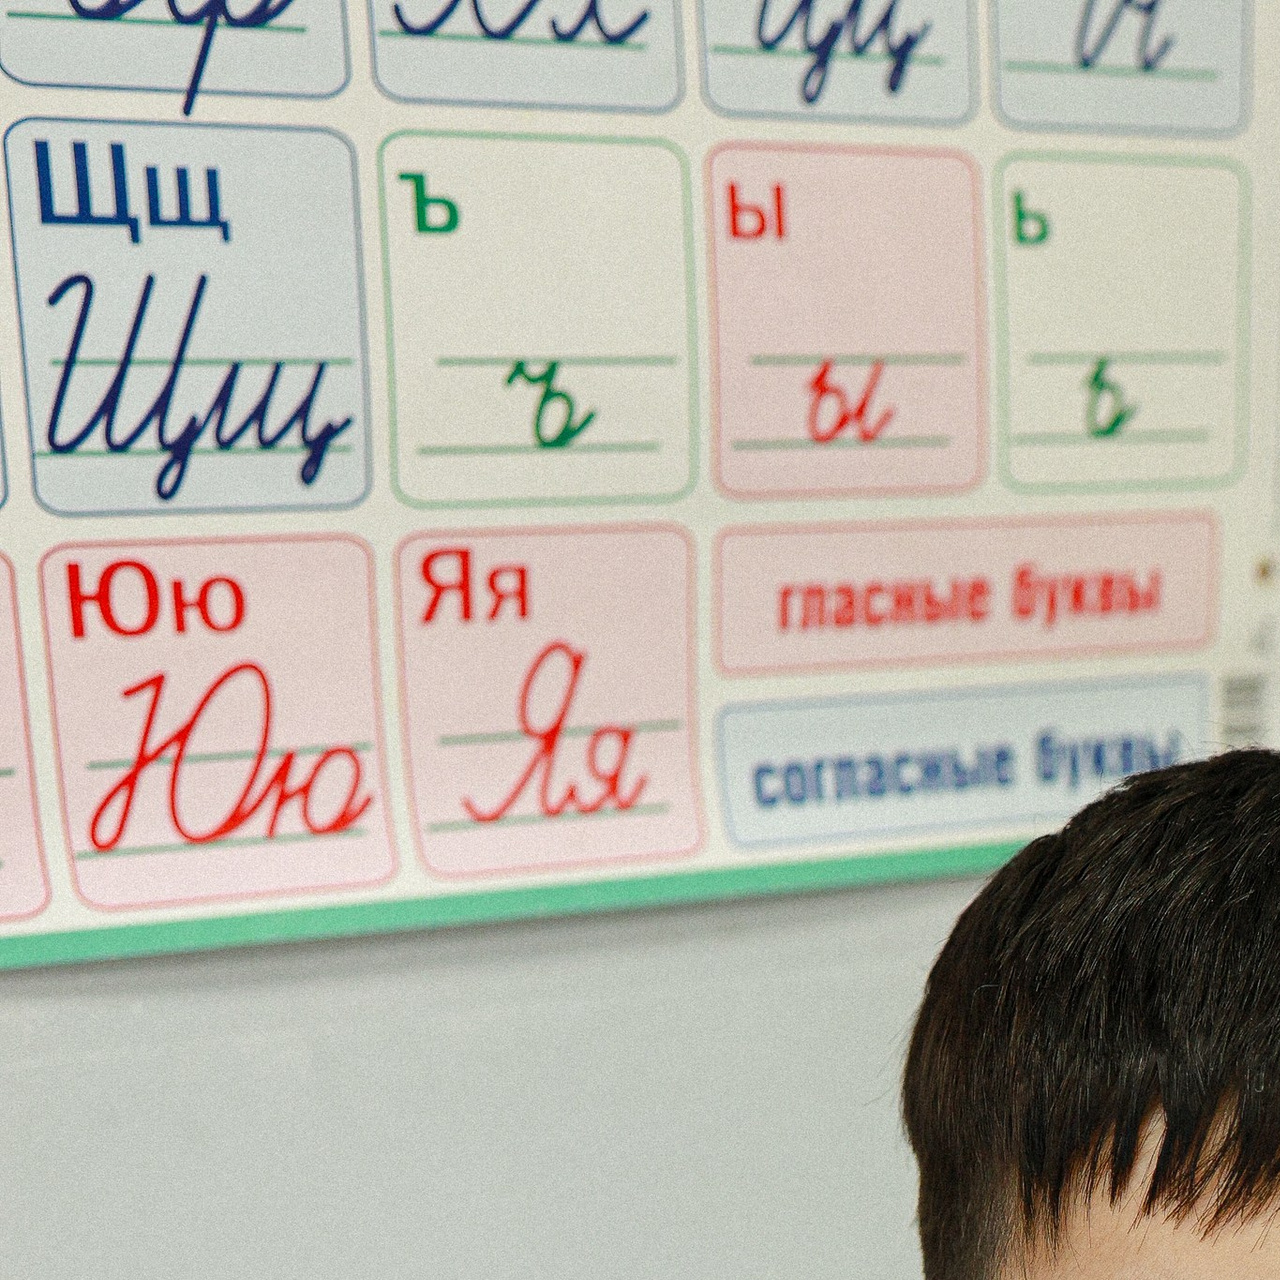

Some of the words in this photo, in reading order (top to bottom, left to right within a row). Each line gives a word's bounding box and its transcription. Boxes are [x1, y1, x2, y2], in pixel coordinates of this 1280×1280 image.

[34, 140, 230, 245] Щщ
[66, 560, 247, 640] Юю
[419, 547, 530, 627] Яя
[777, 574, 990, 633] гласные
[1011, 560, 1162, 631] буквы
[90, 663, 374, 853] Юю
[461, 640, 649, 824] Яя
[752, 742, 1013, 809] согласные
